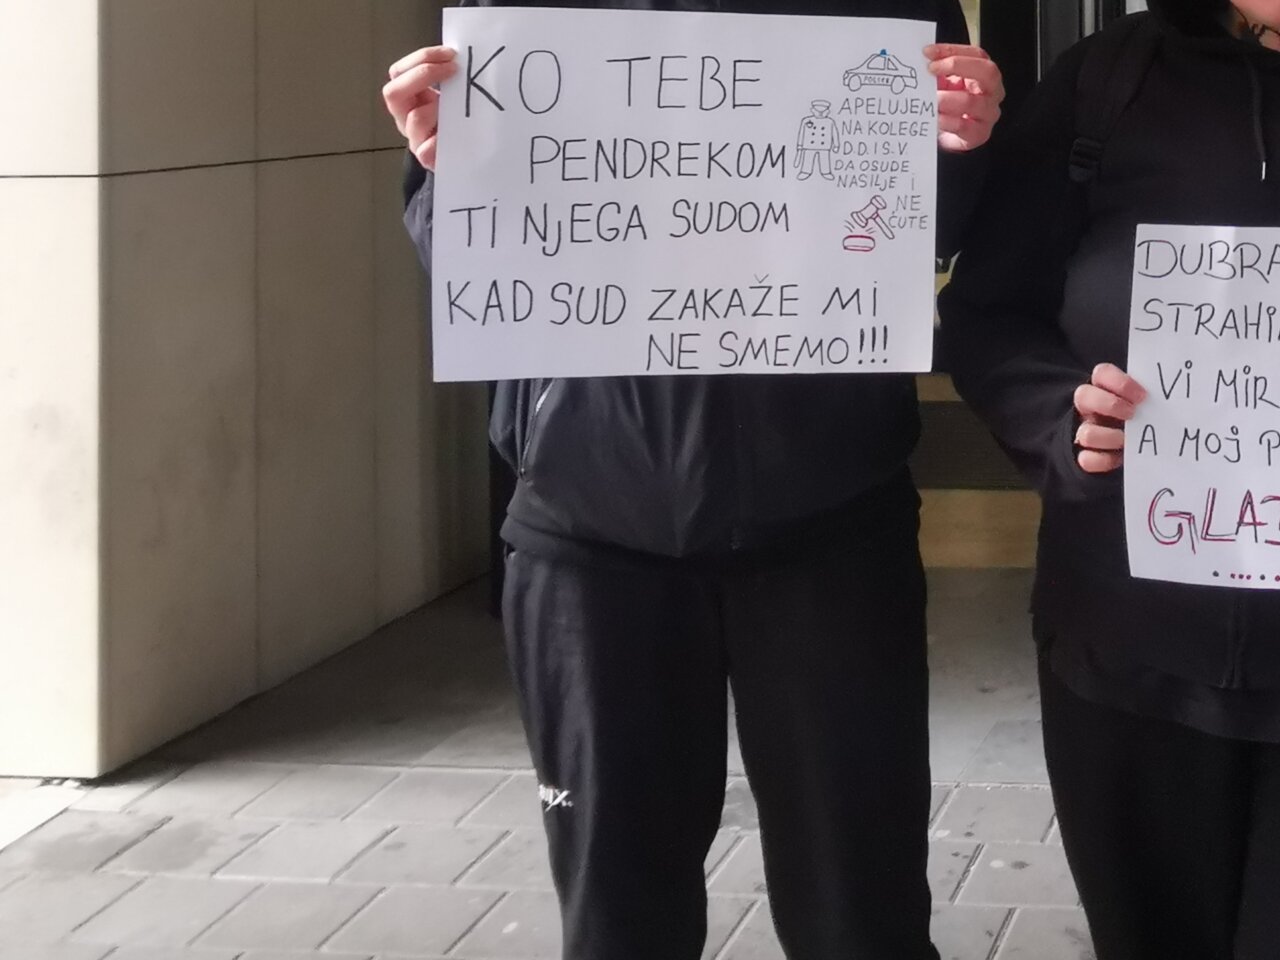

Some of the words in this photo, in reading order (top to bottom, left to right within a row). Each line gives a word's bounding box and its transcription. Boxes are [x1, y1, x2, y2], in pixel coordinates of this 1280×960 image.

[464, 45, 562, 117] KO
[606, 55, 763, 111] TEBE
[837, 98, 935, 117] APELUJEM
[841, 121, 863, 136] NA
[868, 121, 930, 136] KOLEGE
[530, 136, 786, 184] PENDREKOM
[834, 160, 854, 171] DA
[859, 160, 909, 172] OSUDE
[669, 199, 790, 239] SUDOM
[895, 195, 921, 211] NE
[446, 280, 534, 327] KAD
[550, 282, 627, 326] SUD
[647, 274, 799, 321] ZAKAŽE
[646, 333, 701, 371] NE
[718, 325, 888, 367] SMEMO!!!
[1138, 424, 1158, 455] A
